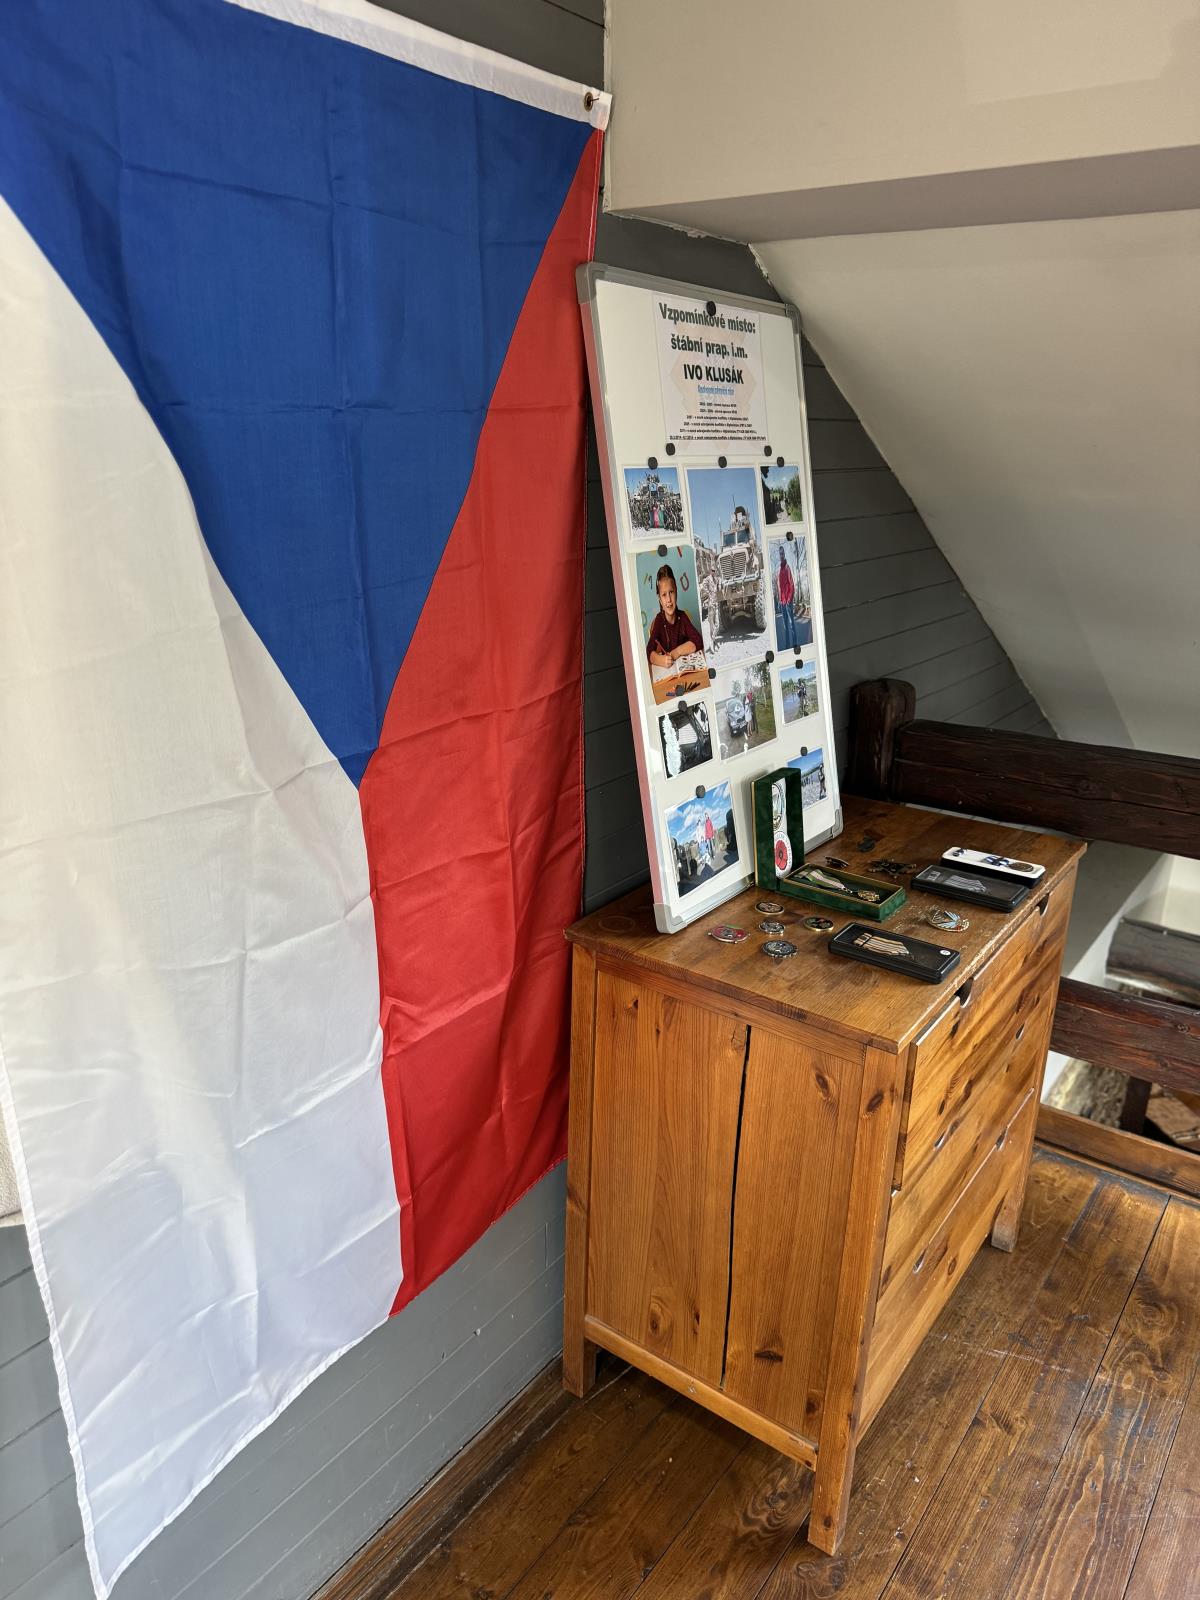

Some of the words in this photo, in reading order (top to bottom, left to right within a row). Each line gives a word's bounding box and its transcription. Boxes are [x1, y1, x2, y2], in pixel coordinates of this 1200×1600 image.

[658, 302, 726, 329] Vzpomínkové
[728, 315, 756, 334] místo:
[670, 333, 703, 352] štábní
[705, 342, 730, 359] prap.
[731, 346, 748, 359] i.m.
[683, 363, 703, 381] IVO
[705, 365, 744, 385] KLUSÁK
